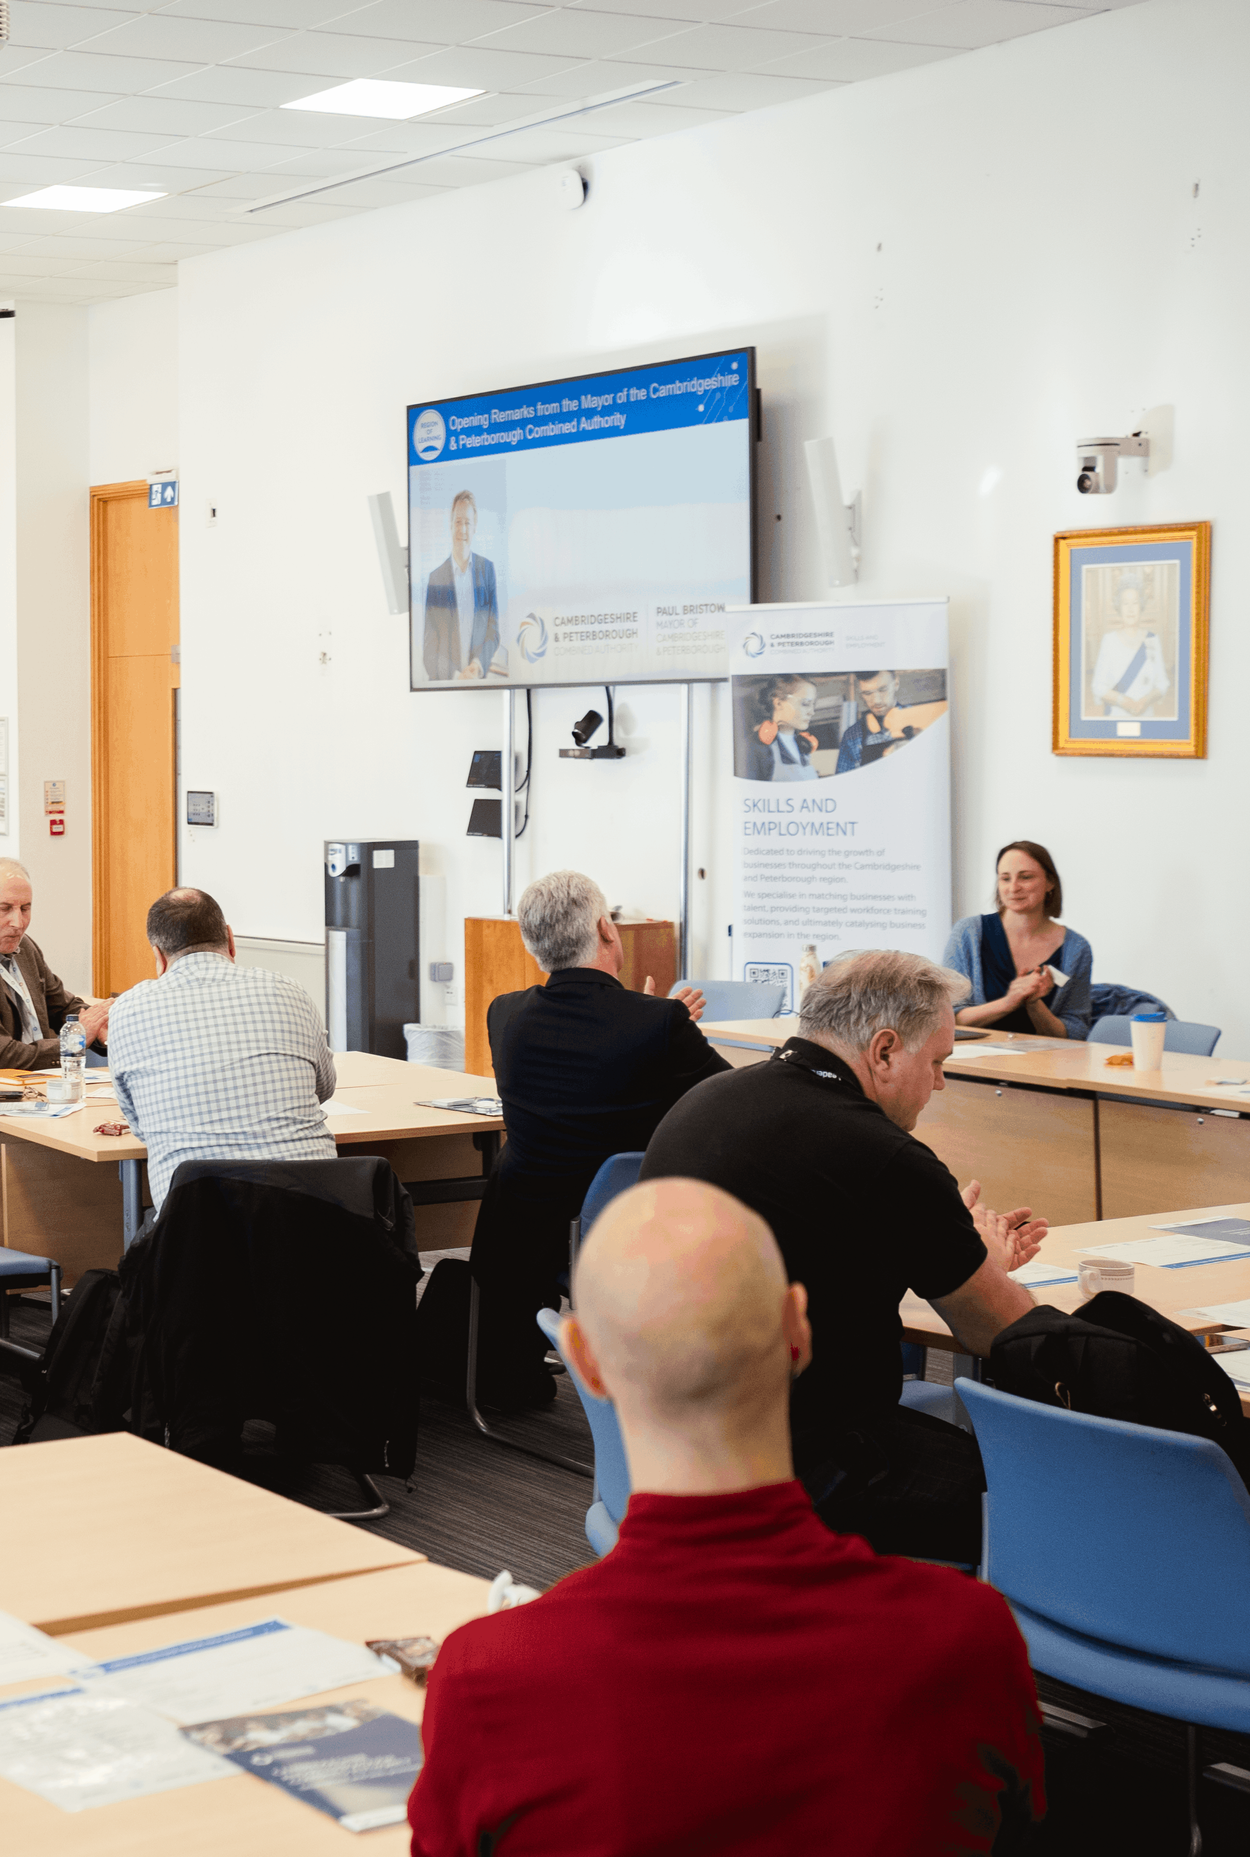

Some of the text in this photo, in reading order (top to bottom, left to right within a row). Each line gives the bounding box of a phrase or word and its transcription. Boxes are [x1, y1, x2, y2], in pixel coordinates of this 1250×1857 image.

[449, 374, 740, 431] Opening Remarks from the Mayor of the Cambridgeshire
[450, 412, 627, 450] & Peterborough Combined Authority
[418, 435, 442, 443] LEARNING
[656, 602, 726, 616] PAUL BRISTOW
[554, 612, 638, 627] CAMBRIDGESHIRE
[656, 618, 699, 630] MAYOR OF
[554, 628, 638, 643] & PETERBOROUGH
[656, 630, 725, 643] CAMBRIDGESHIRE
[770, 631, 834, 640] CAMBRIDGESHIRE
[662, 644, 726, 655] PETERBOROUGH
[743, 798, 837, 813] SKILLS AND
[744, 821, 859, 837] EMPLOYMENT
[743, 848, 784, 856] Dedicated
[797, 848, 826, 858] driving
[828, 848, 842, 856] the
[844, 849, 874, 858] growth
[876, 849, 885, 857] of
[743, 861, 921, 873] businesses throughout the Cambridgeshire
[760, 874, 818, 885] Peterborough
[819, 876, 848, 885] region.
[743, 891, 756, 899] We
[758, 891, 797, 900] specialise
[808, 892, 848, 902] matching
[850, 893, 896, 901] businesses
[897, 894, 916, 902] with
[743, 905, 927, 918] talent, providing targeted workforce training
[743, 918, 782, 927] solutions,
[802, 919, 843, 929] ultimately
[845, 921, 887, 930] catalysing
[890, 921, 926, 930] business
[743, 932, 785, 941] expansion
[797, 932, 811, 940] the
[812, 934, 842, 942] region.
